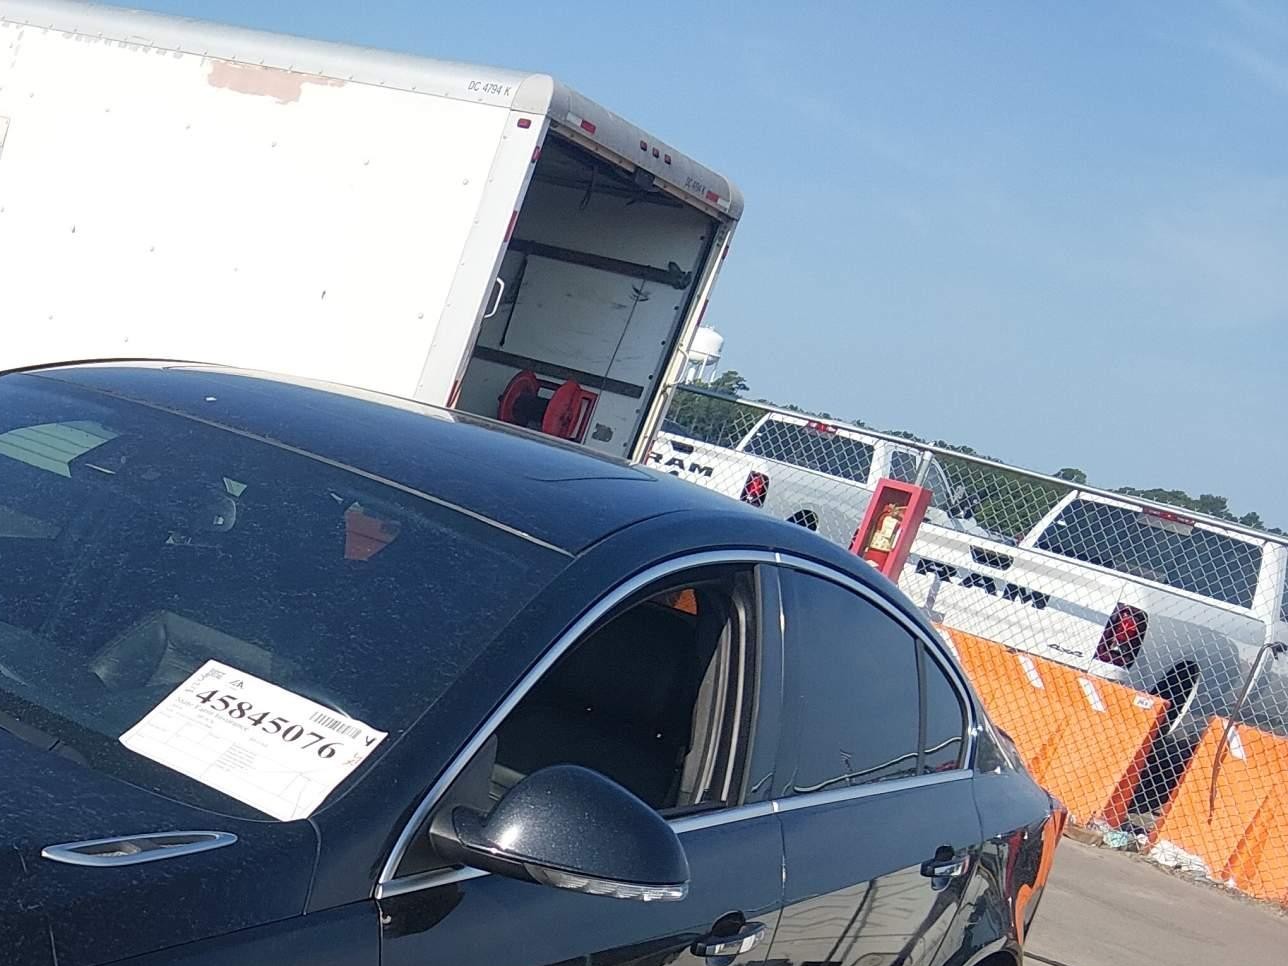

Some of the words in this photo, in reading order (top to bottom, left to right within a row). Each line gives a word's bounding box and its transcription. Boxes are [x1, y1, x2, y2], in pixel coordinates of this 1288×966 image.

[468, 80, 481, 91] DC
[483, 83, 503, 95] 4794
[504, 86, 512, 96] K
[648, 451, 714, 477] RAM
[915, 557, 1051, 610] RAM
[195, 689, 345, 759] 45845076
